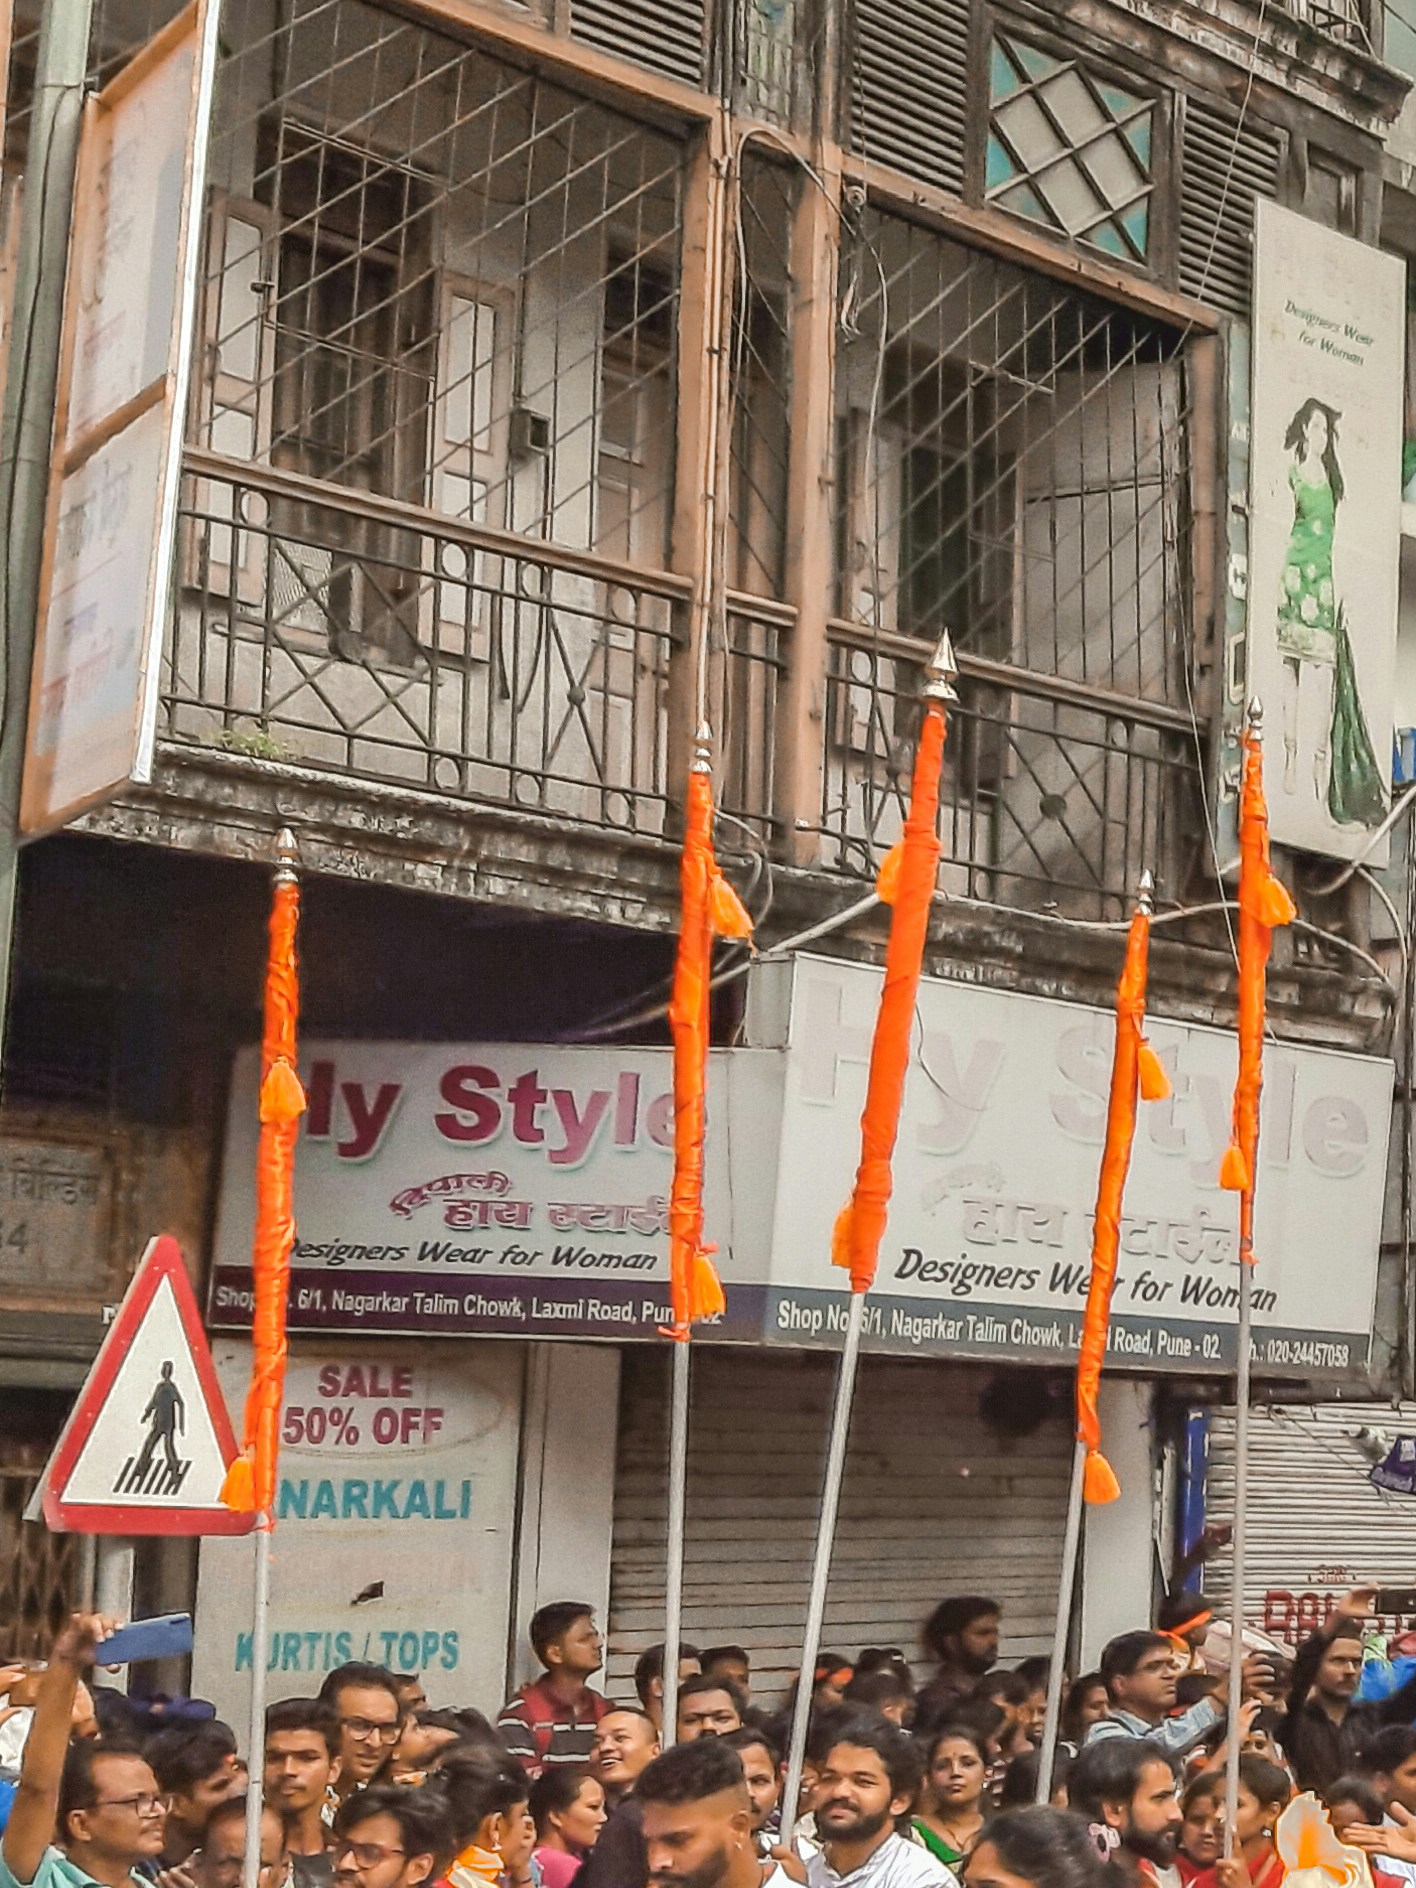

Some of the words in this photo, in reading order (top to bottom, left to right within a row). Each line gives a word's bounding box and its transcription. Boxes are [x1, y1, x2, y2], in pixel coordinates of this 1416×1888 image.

[417, 1241, 490, 1265] Wear
[499, 1243, 542, 1269] for
[551, 1247, 658, 1271] Woman
[894, 1248, 1041, 1297] Designers
[1049, 1263, 1121, 1300] Wer
[1130, 1270, 1175, 1302] for
[332, 1291, 409, 1320] Nagarkar
[413, 1295, 460, 1316] Talim
[464, 1296, 527, 1323] Chowk,
[531, 1296, 585, 1322] Laxmi
[587, 1299, 638, 1327] Road,
[641, 1300, 674, 1325] Pun
[776, 1302, 823, 1336] Shop
[890, 1314, 963, 1347] Nagarkar
[966, 1318, 1007, 1346] Talim
[1010, 1320, 1065, 1353] Chowk,
[1114, 1327, 1154, 1358] Road,
[1157, 1333, 1193, 1359] Pune
[1266, 1341, 1351, 1370] 020-24457058
[319, 1365, 412, 1399] SALE
[282, 1408, 360, 1446] 50%
[372, 1406, 446, 1445] OFF
[277, 1478, 473, 1522] NARKALI
[380, 1630, 461, 1672] TOPS
